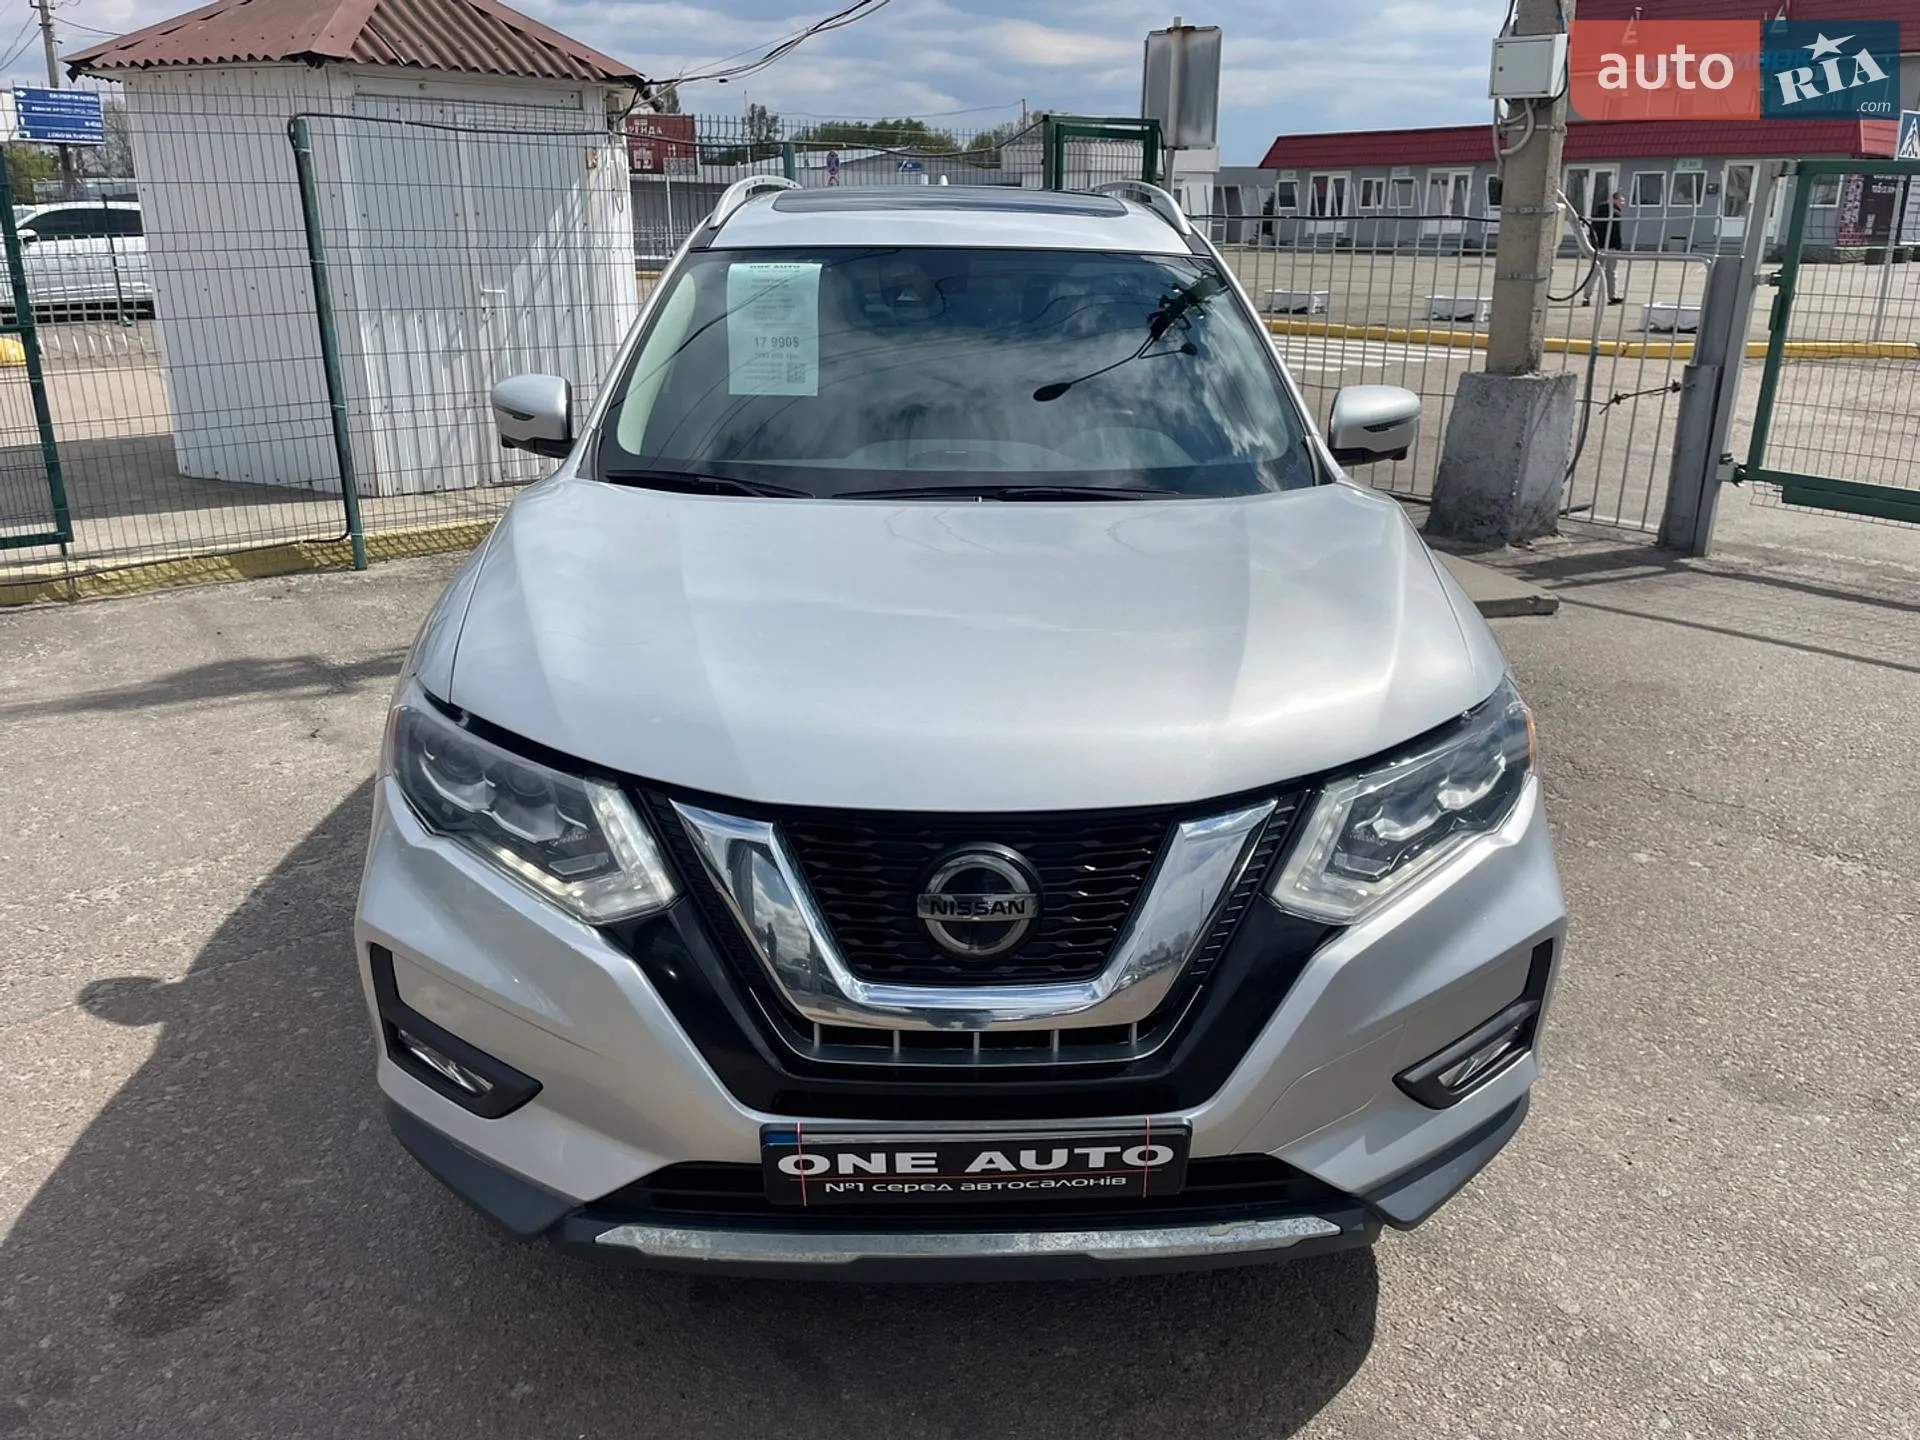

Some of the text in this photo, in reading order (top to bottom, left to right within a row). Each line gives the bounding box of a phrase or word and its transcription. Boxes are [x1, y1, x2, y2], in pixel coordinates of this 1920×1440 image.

[754, 336, 800, 348] 17 990$
[930, 900, 1026, 916] NISSAN
[777, 1144, 1174, 1176] ONE AUTO
[872, 1181, 954, 1193] серед
[960, 1176, 1128, 1191] автосалонів
